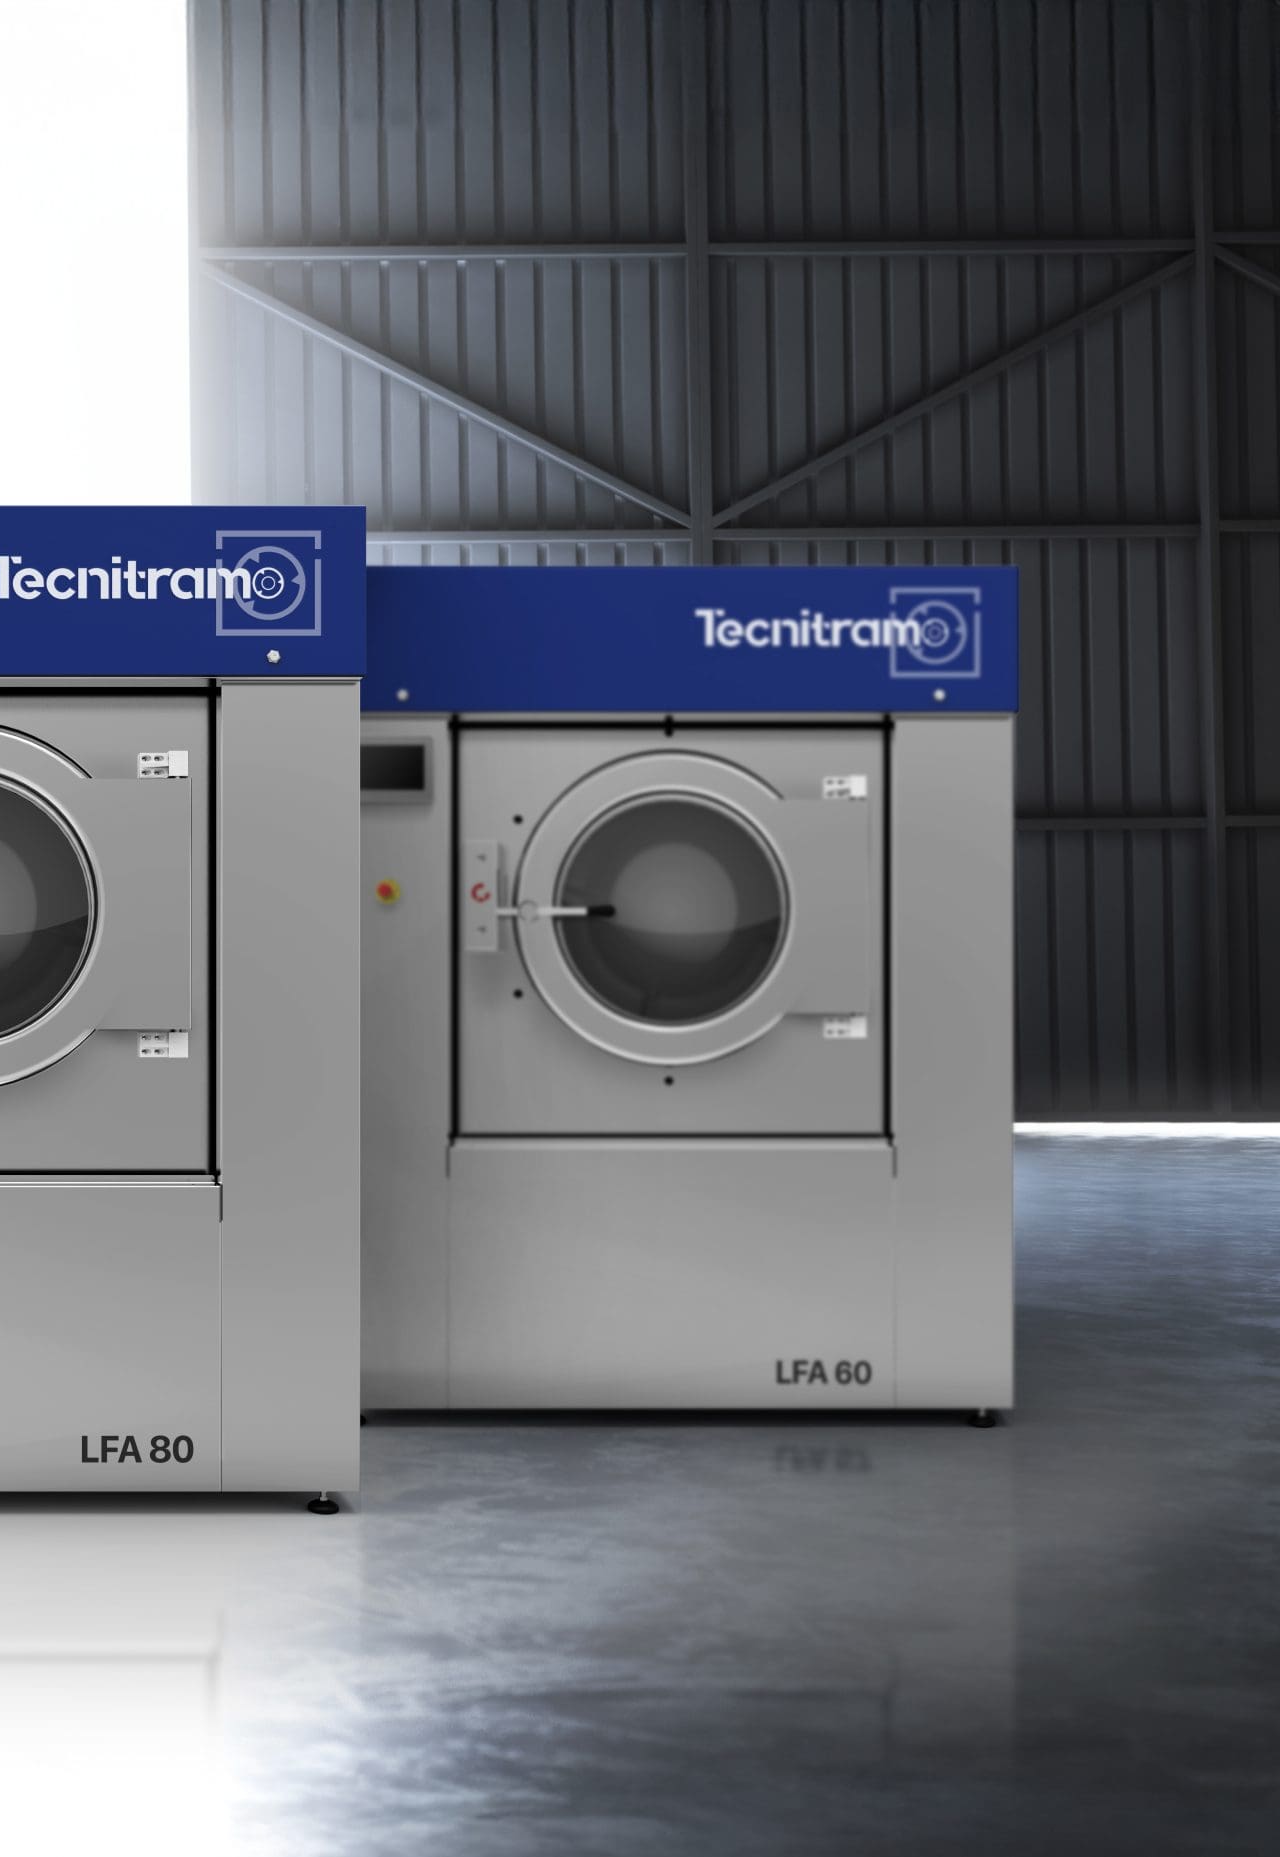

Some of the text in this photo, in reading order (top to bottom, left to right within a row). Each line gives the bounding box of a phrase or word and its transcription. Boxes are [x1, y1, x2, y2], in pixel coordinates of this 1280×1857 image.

[694, 608, 922, 648] Tecnitram
[775, 1359, 873, 1385] LFA 60
[81, 1434, 195, 1464] LFA 80
